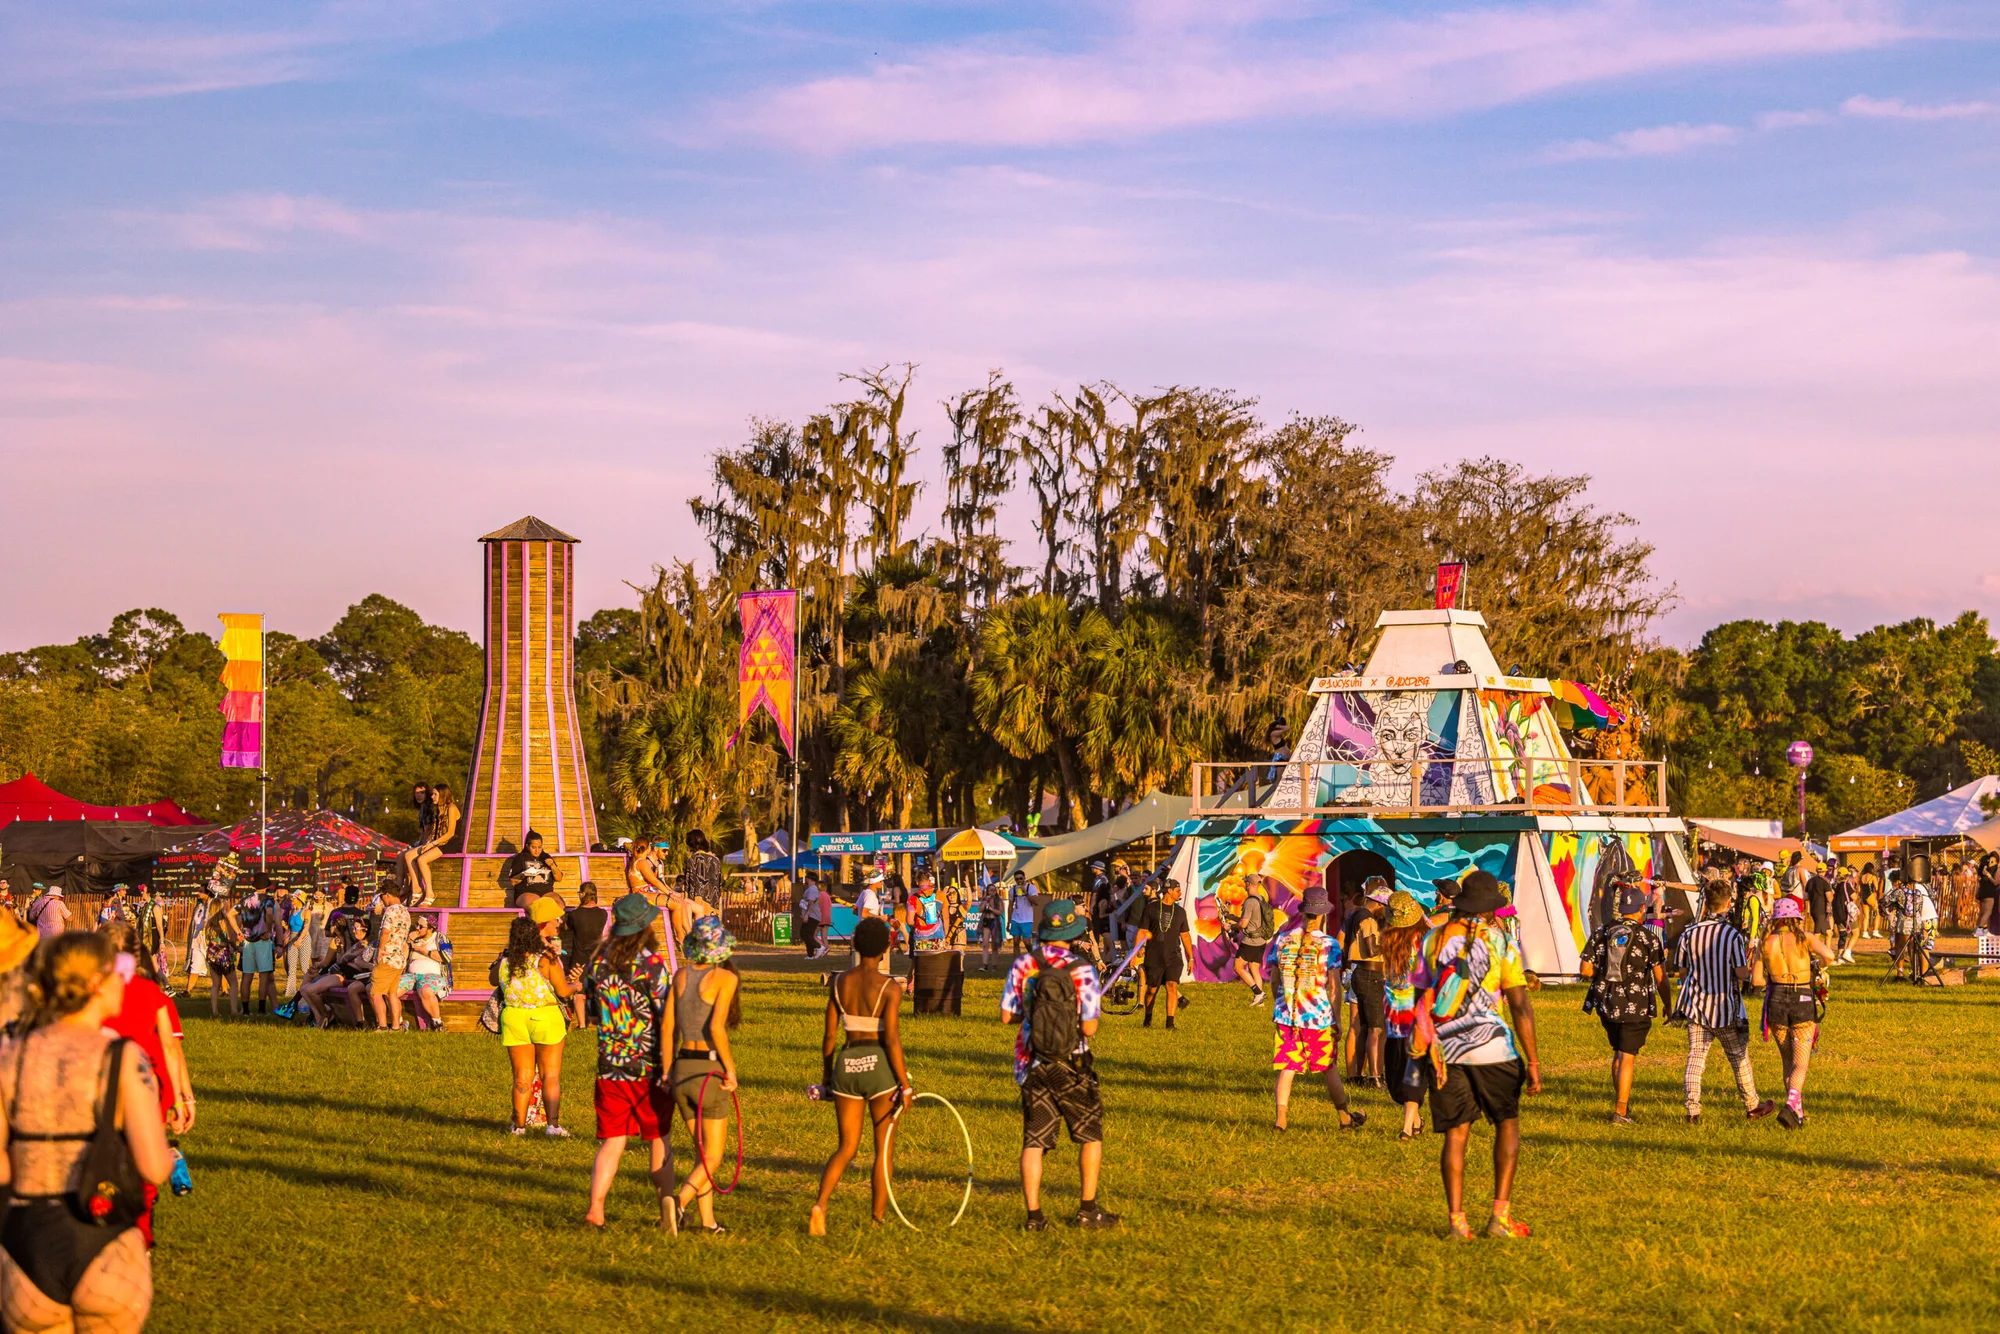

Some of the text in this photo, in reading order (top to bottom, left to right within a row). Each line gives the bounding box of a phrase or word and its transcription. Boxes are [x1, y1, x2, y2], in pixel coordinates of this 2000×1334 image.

[849, 843, 865, 851] LEGS
[844, 1055, 878, 1066] VEGGIE
[845, 1063, 875, 1073] BOOTY
